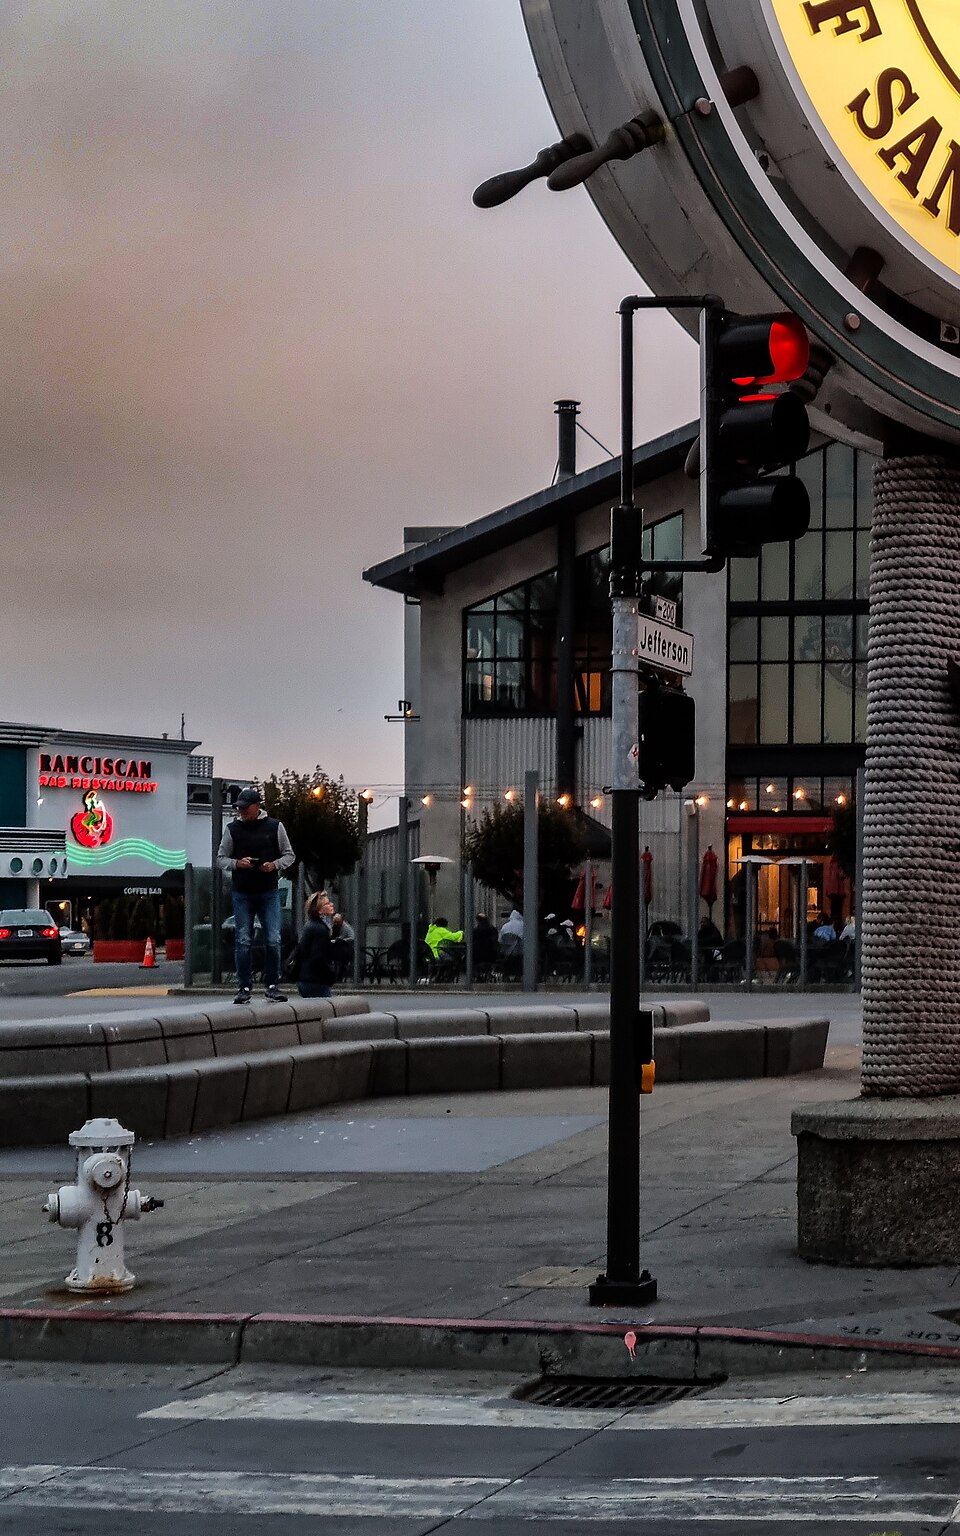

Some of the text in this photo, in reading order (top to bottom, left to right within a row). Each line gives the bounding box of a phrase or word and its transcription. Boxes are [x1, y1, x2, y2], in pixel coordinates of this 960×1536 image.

[640, 626, 688, 665] Jefferson
[71, 777, 158, 793] RESTAURANT
[96, 1222, 114, 1248] 8
